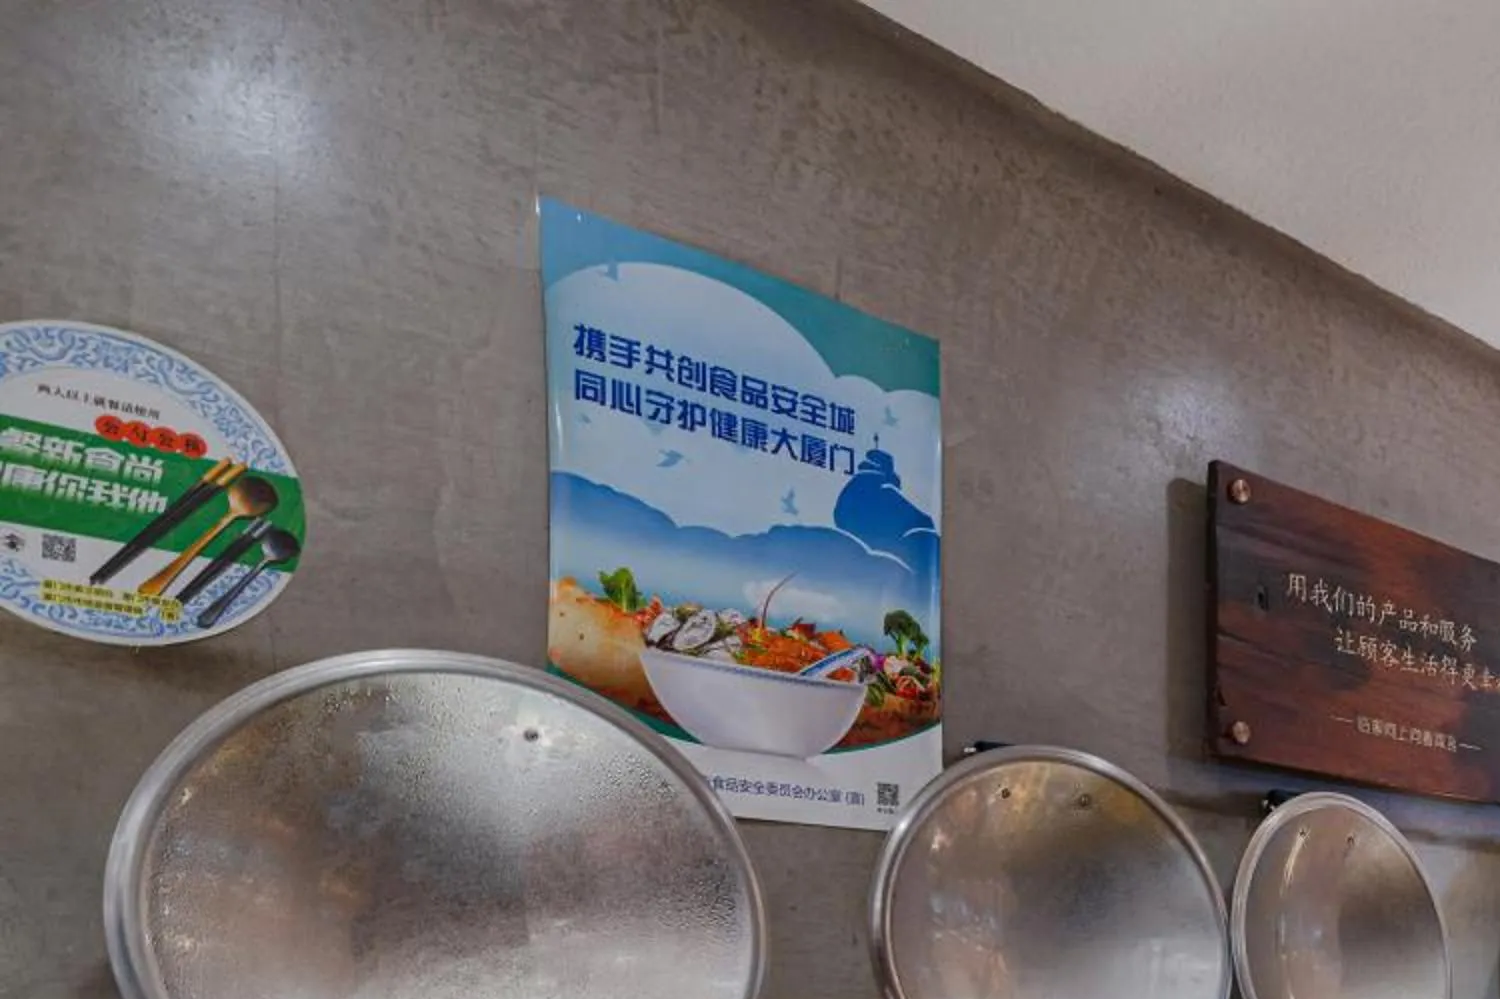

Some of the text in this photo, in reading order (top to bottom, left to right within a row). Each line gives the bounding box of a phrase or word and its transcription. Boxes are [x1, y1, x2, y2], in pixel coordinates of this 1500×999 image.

[573, 324, 855, 435] 携手共创食品安全城
[574, 369, 855, 476] 同心守护健康大厦门
[1287, 573, 1477, 653] 用我们的产品和服务
